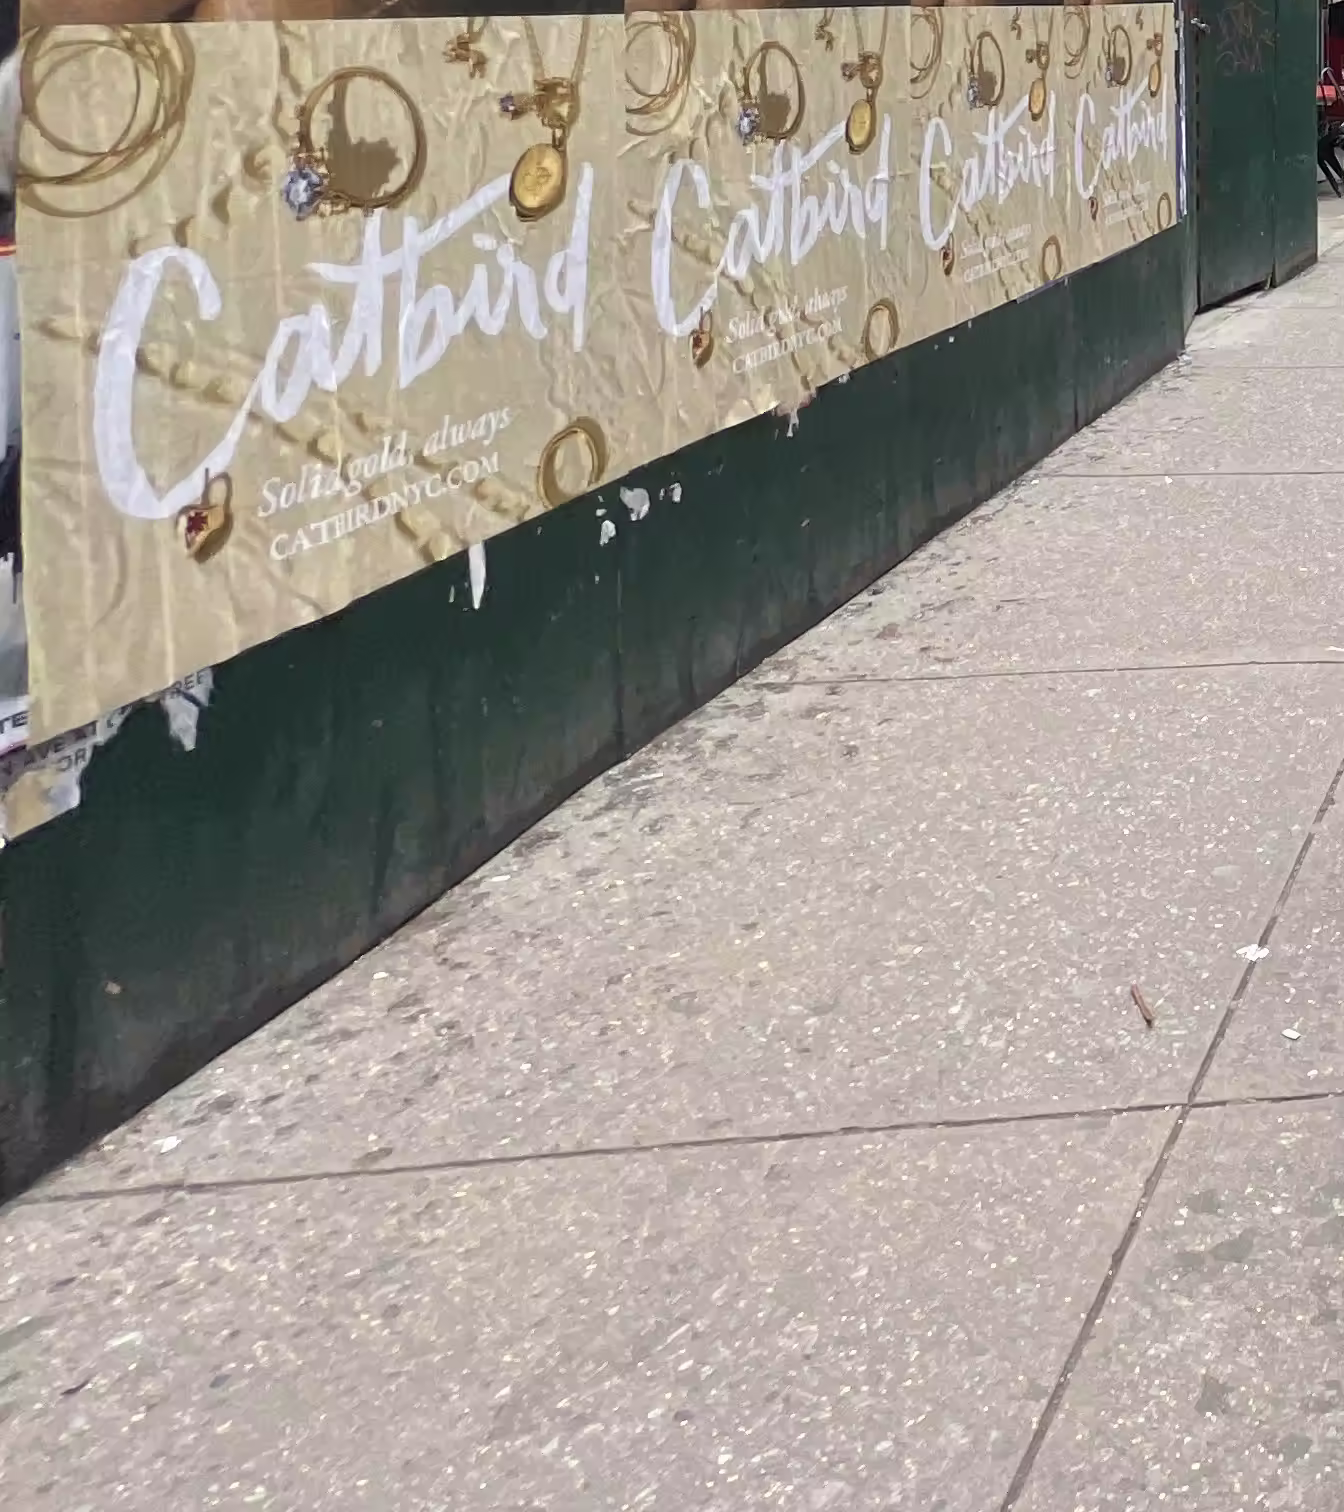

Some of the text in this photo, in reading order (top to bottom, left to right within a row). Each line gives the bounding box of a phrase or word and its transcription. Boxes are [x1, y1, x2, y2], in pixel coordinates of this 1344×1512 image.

[919, 90, 1057, 250] Catbird
[1074, 78, 1168, 199] Catbird
[651, 112, 891, 338] Catbird
[94, 161, 594, 520] Catbird
[423, 406, 513, 458] always
